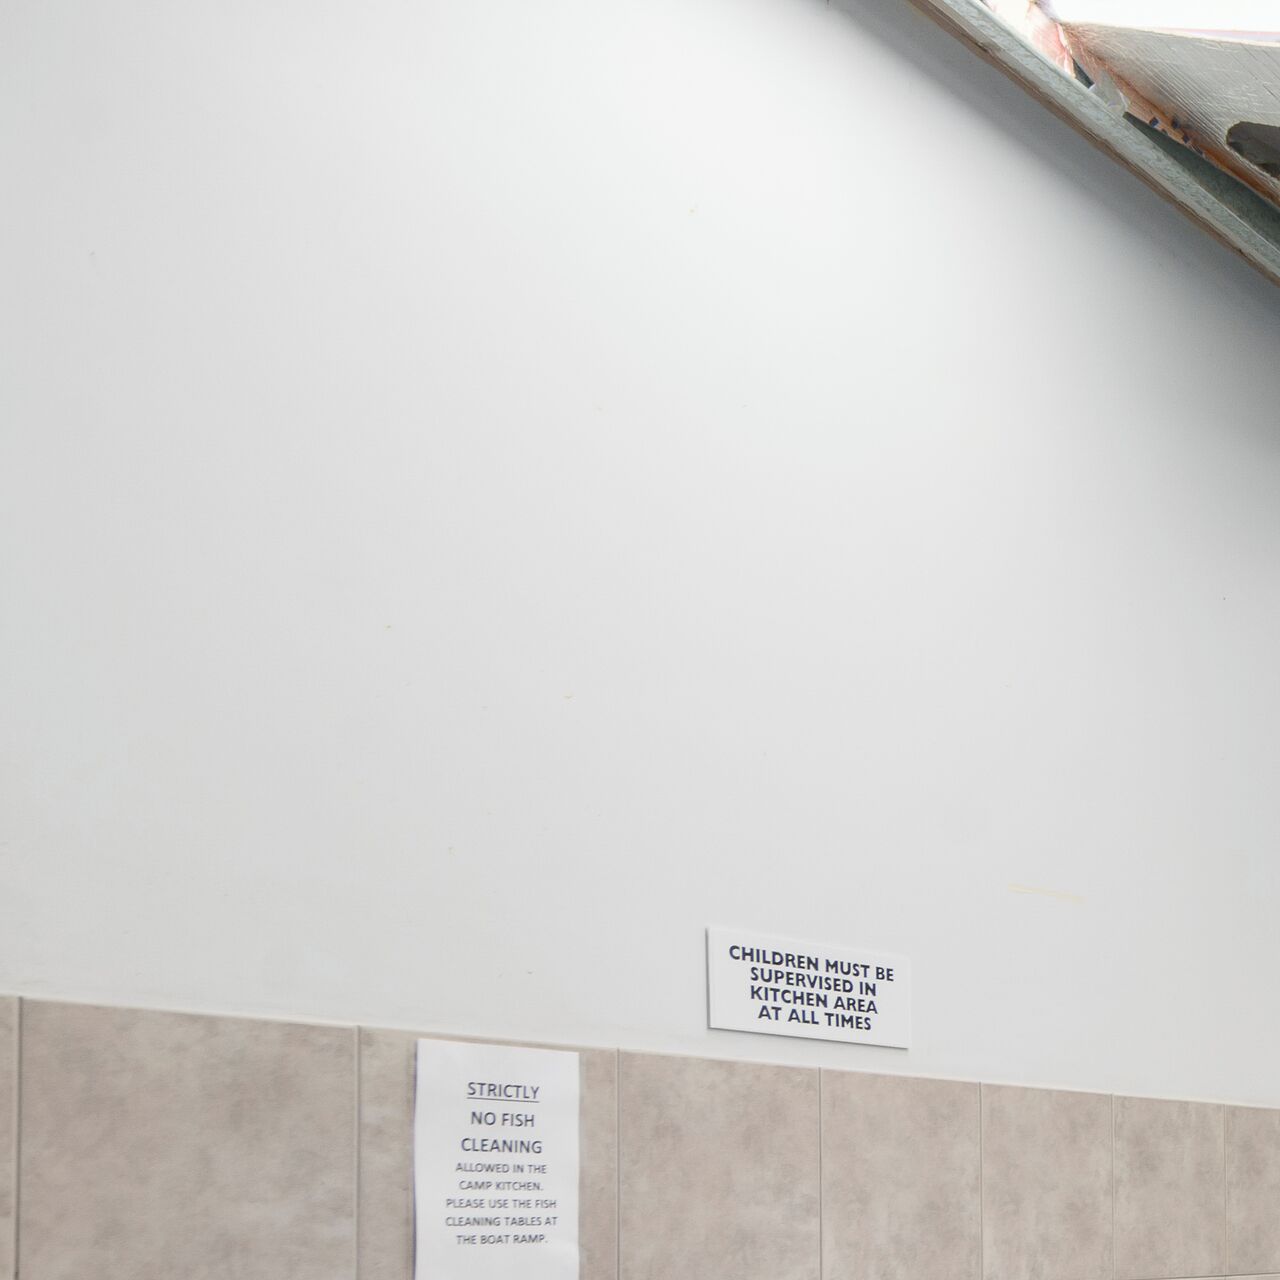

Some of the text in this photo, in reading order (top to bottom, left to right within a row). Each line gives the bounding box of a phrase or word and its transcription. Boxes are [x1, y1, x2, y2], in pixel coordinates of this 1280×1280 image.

[729, 945, 894, 982] CHILDREN MUST BE
[750, 967, 877, 996] SUPERVISED IN
[750, 985, 878, 1014] KITCHEN AREA
[758, 1005, 872, 1030] AT ALL TIMES
[466, 1081, 540, 1100] STRICTLY
[471, 1111, 535, 1127] NO FISH
[461, 1138, 543, 1154] CLEANING
[455, 1162, 547, 1174] ALLOWED IN THE
[459, 1180, 544, 1191] CAMP KITCHEN.
[446, 1198, 557, 1209] PLEASE USE THE FISH
[445, 1216, 558, 1226] CLEANING TABLES AT
[456, 1234, 548, 1245] THE BOAT RAMP.
